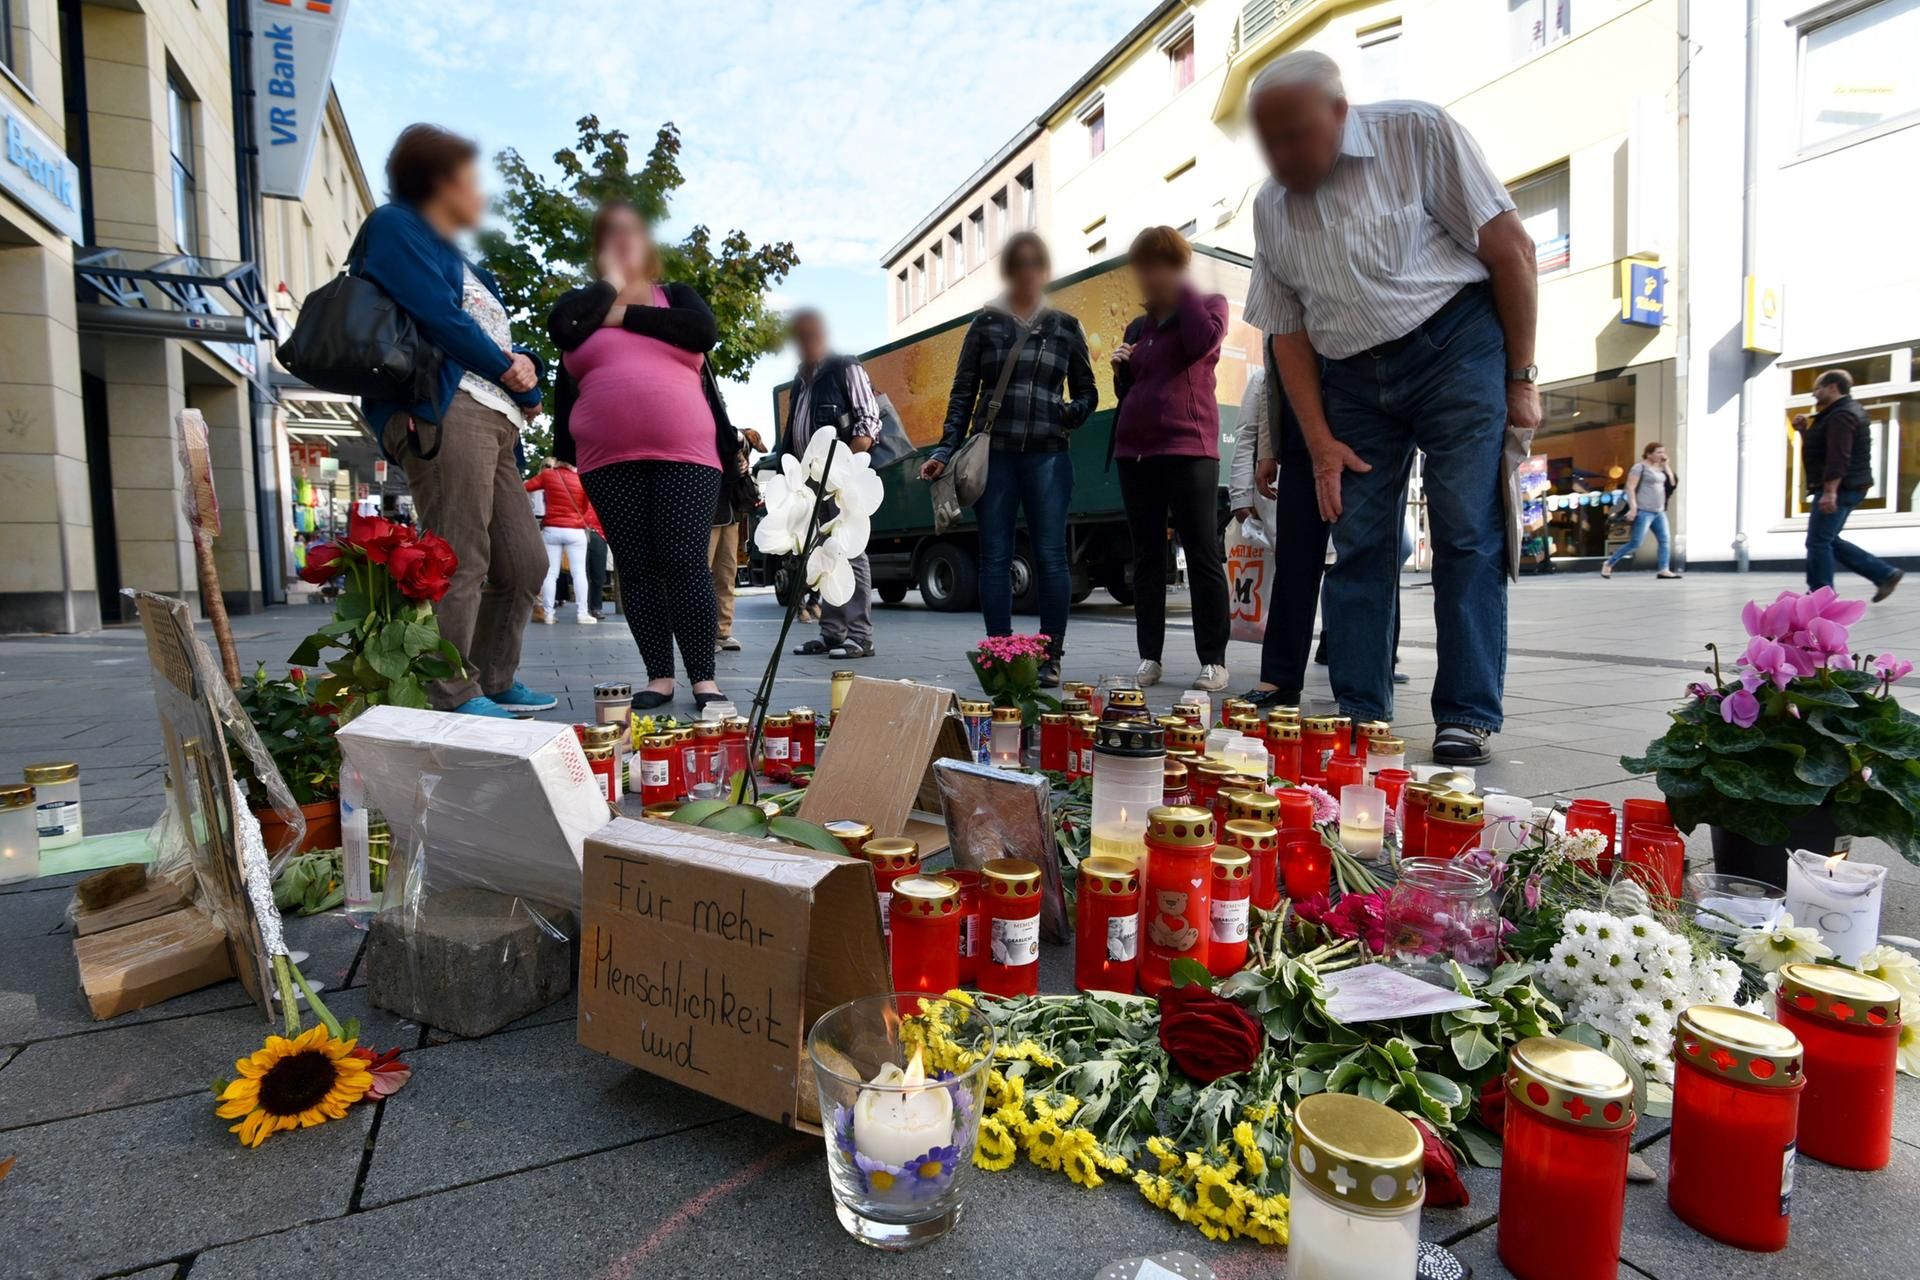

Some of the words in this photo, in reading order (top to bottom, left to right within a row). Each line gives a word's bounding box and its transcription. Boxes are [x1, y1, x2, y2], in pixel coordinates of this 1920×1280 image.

[263, 22, 296, 99] Bank
[7, 113, 75, 212] Bank
[269, 106, 298, 146] VR
[604, 855, 672, 922] Für
[693, 888, 774, 947] mehr
[594, 926, 789, 1048] Menschlichkeit
[641, 1025, 711, 1075] und
